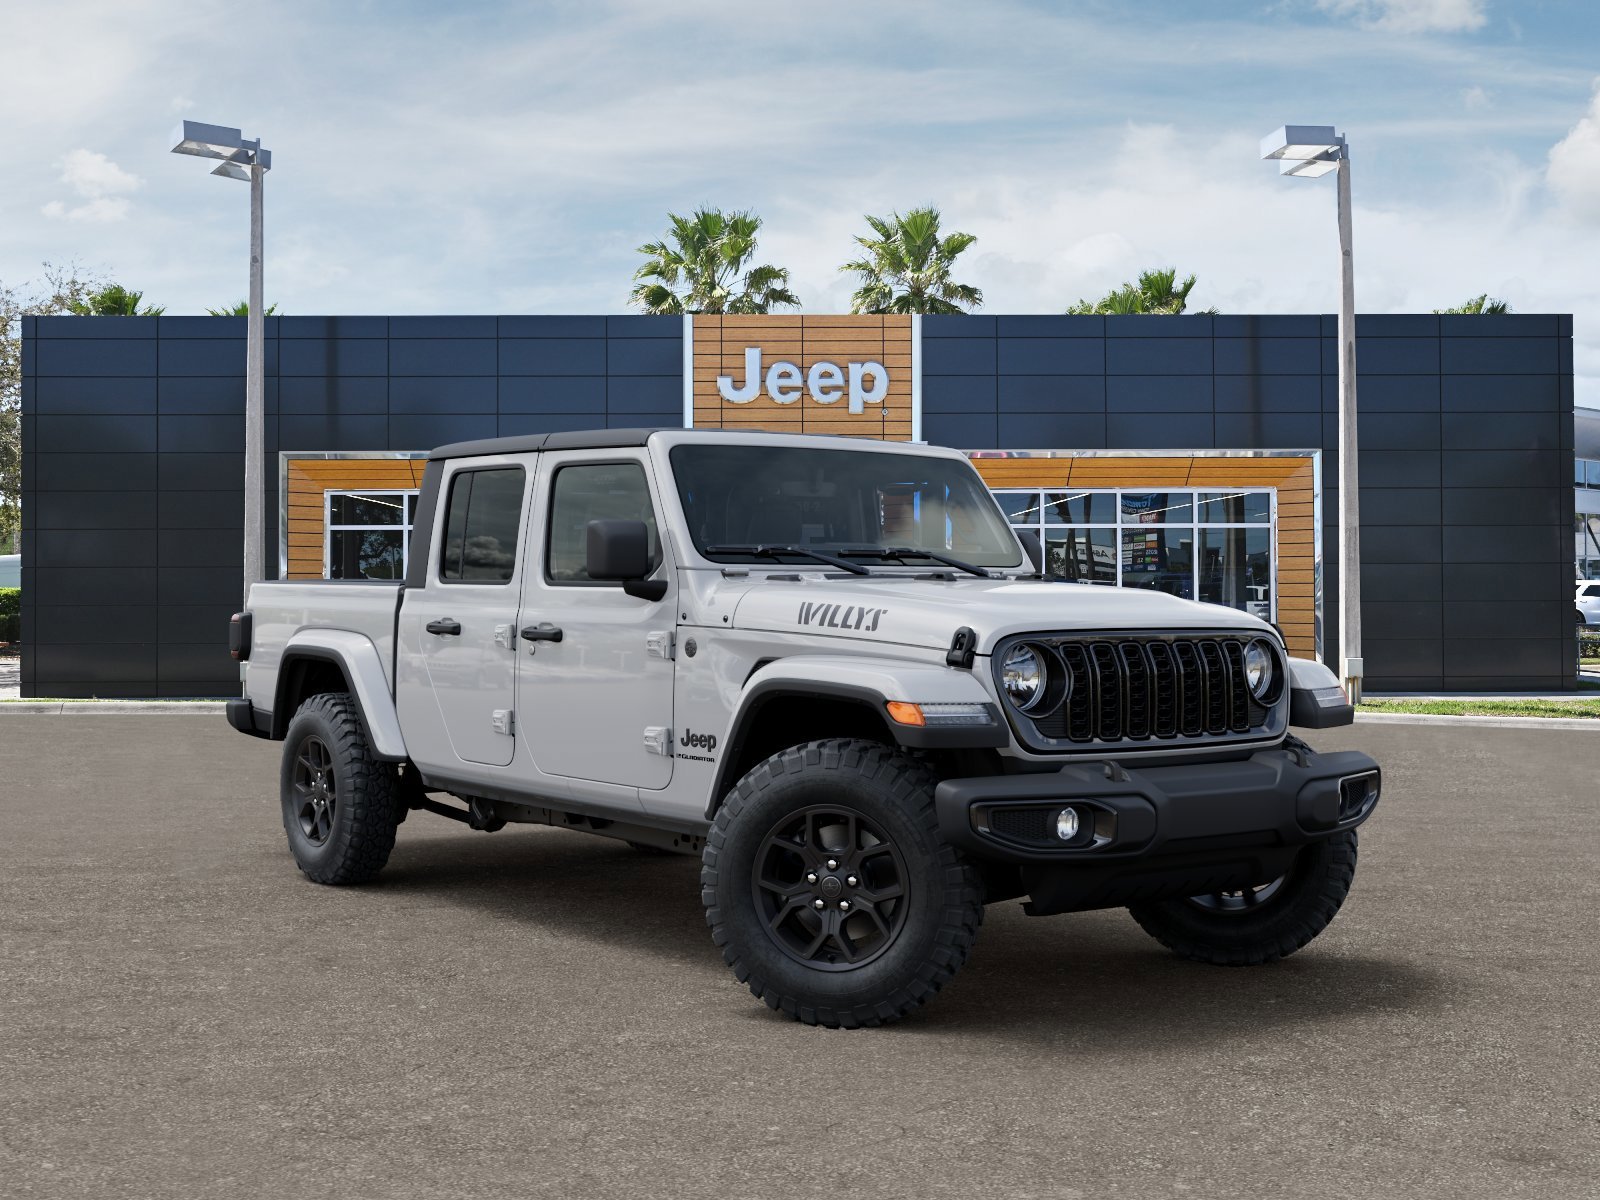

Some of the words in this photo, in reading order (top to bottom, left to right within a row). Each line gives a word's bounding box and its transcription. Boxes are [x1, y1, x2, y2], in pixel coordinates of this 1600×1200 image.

[716, 347, 890, 415] Jeep
[797, 601, 888, 632] WILLYS
[680, 728, 717, 752] Jeep
